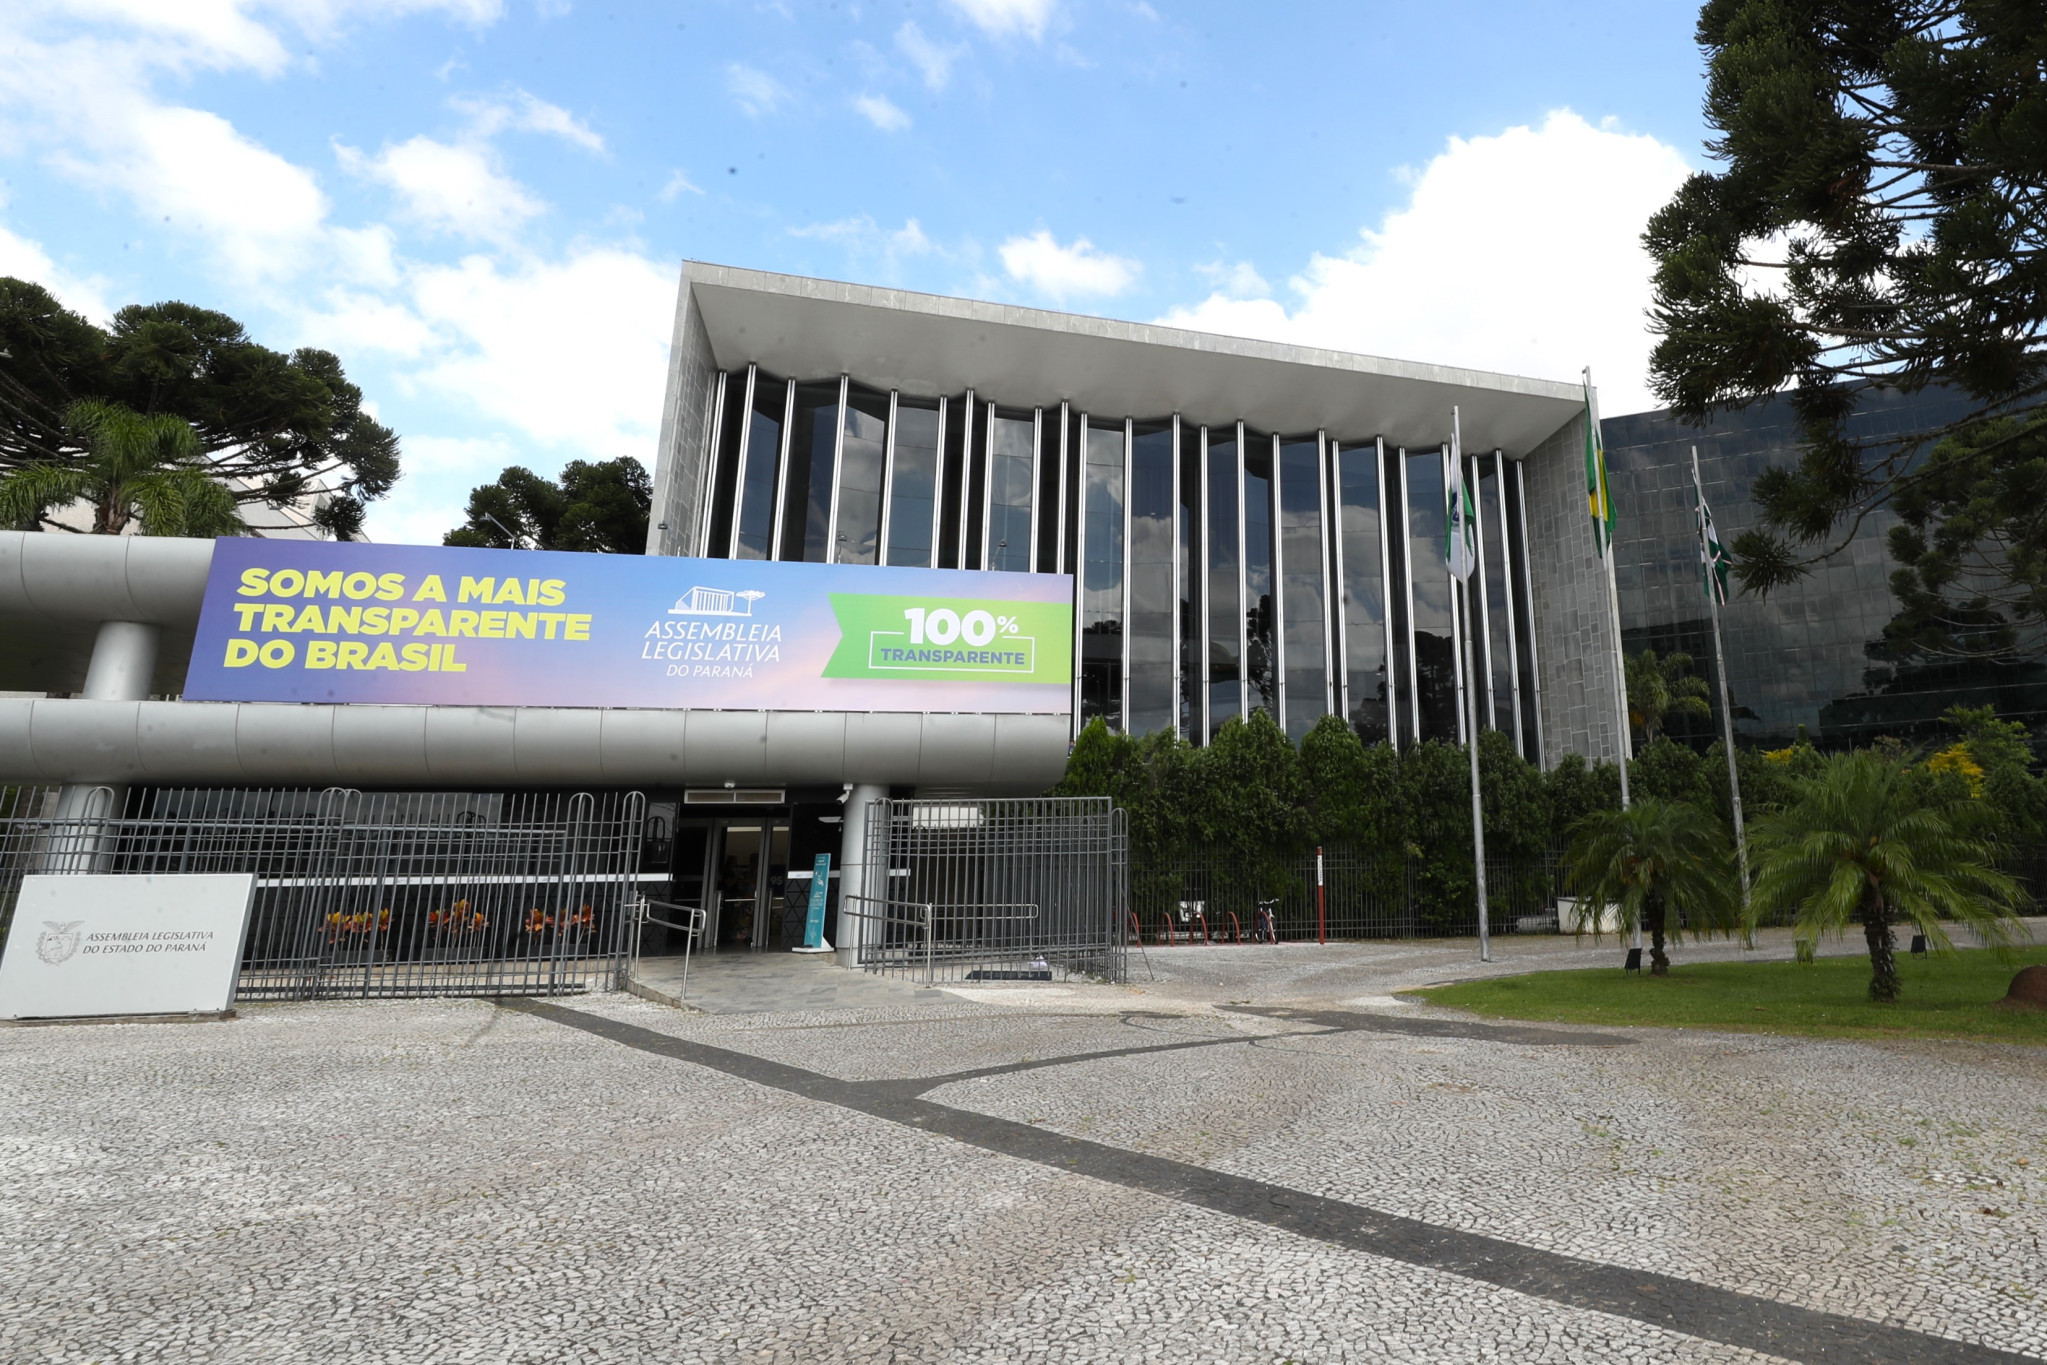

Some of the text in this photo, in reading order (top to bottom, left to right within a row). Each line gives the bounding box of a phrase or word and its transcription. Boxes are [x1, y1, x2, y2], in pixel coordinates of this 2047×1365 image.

[236, 568, 567, 607] SOMOS A MAIS
[233, 603, 593, 641] TRANSPARENTE
[644, 621, 782, 642] ASSEMBLEIA
[904, 607, 1019, 647] 100%
[223, 639, 468, 672] DO BRASIL
[641, 641, 781, 662] LEGISLATIVA
[881, 648, 1026, 665] TRANSPARENTE
[666, 663, 754, 678] DO PARANÁ
[87, 931, 214, 942] ASSEMBLEIA LEGISLATIVA
[82, 941, 208, 954] DO ESTADO DO PARANÁ
